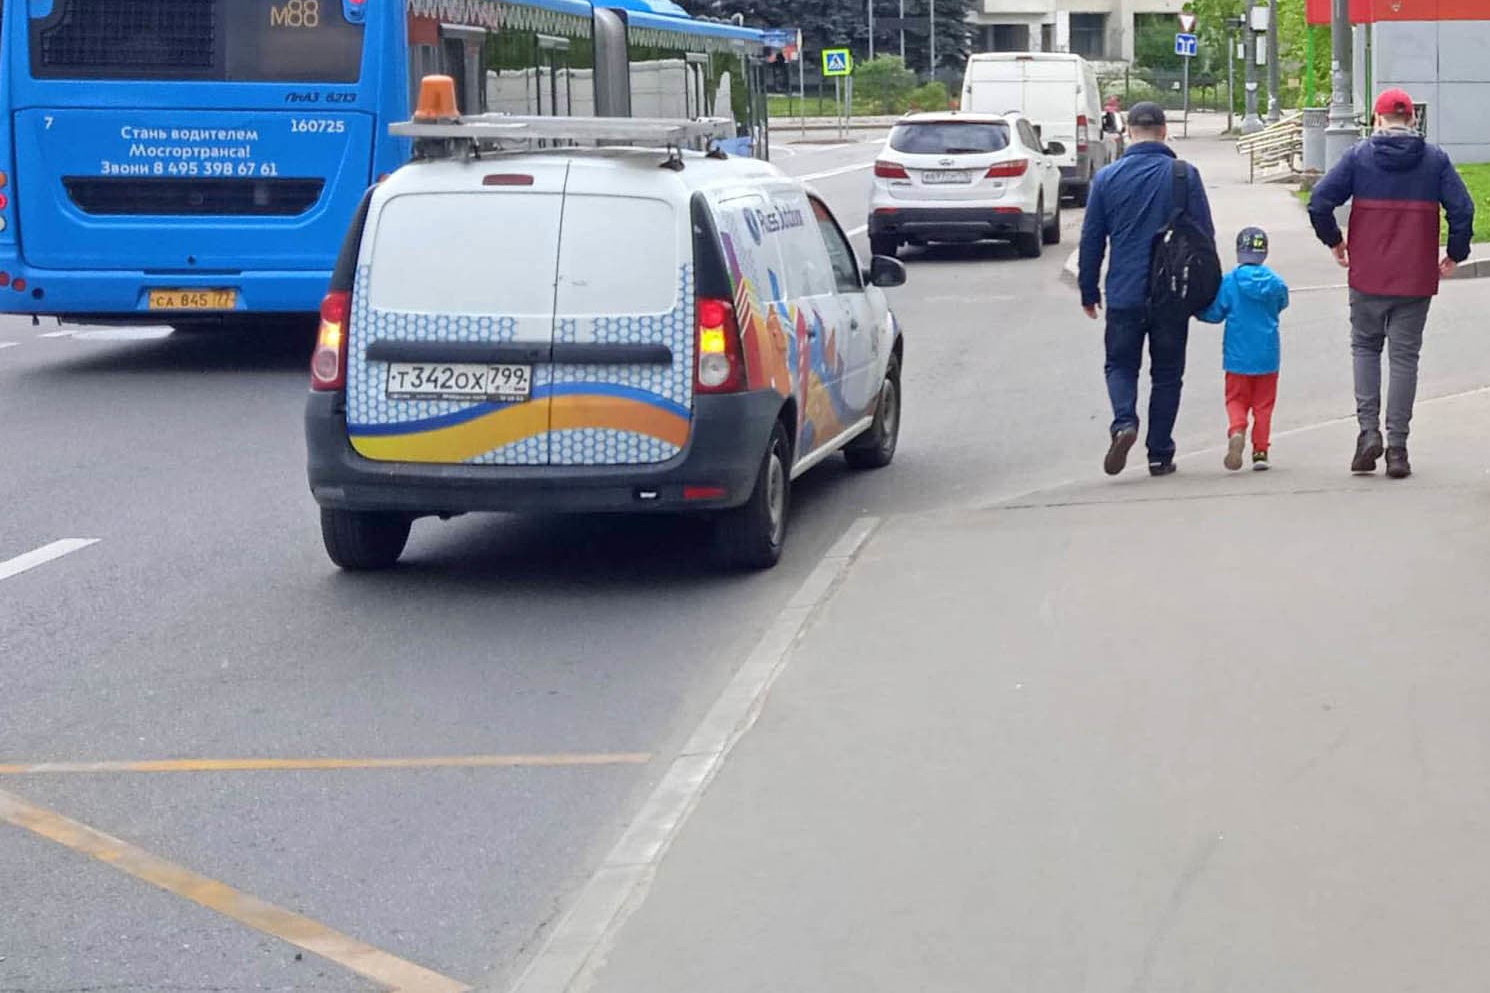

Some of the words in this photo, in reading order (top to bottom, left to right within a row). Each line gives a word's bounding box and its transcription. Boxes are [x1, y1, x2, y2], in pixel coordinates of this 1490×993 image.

[291, 118, 345, 133] 160725
[121, 126, 168, 139] Стань
[171, 128, 259, 141] водителем
[129, 143, 251, 159] Мосгортранса!
[100, 161, 149, 175] Звони
[153, 161, 164, 174] 8
[168, 161, 198, 175] 495
[203, 161, 233, 175] 398
[237, 162, 256, 175] 67
[260, 163, 278, 176] 61
